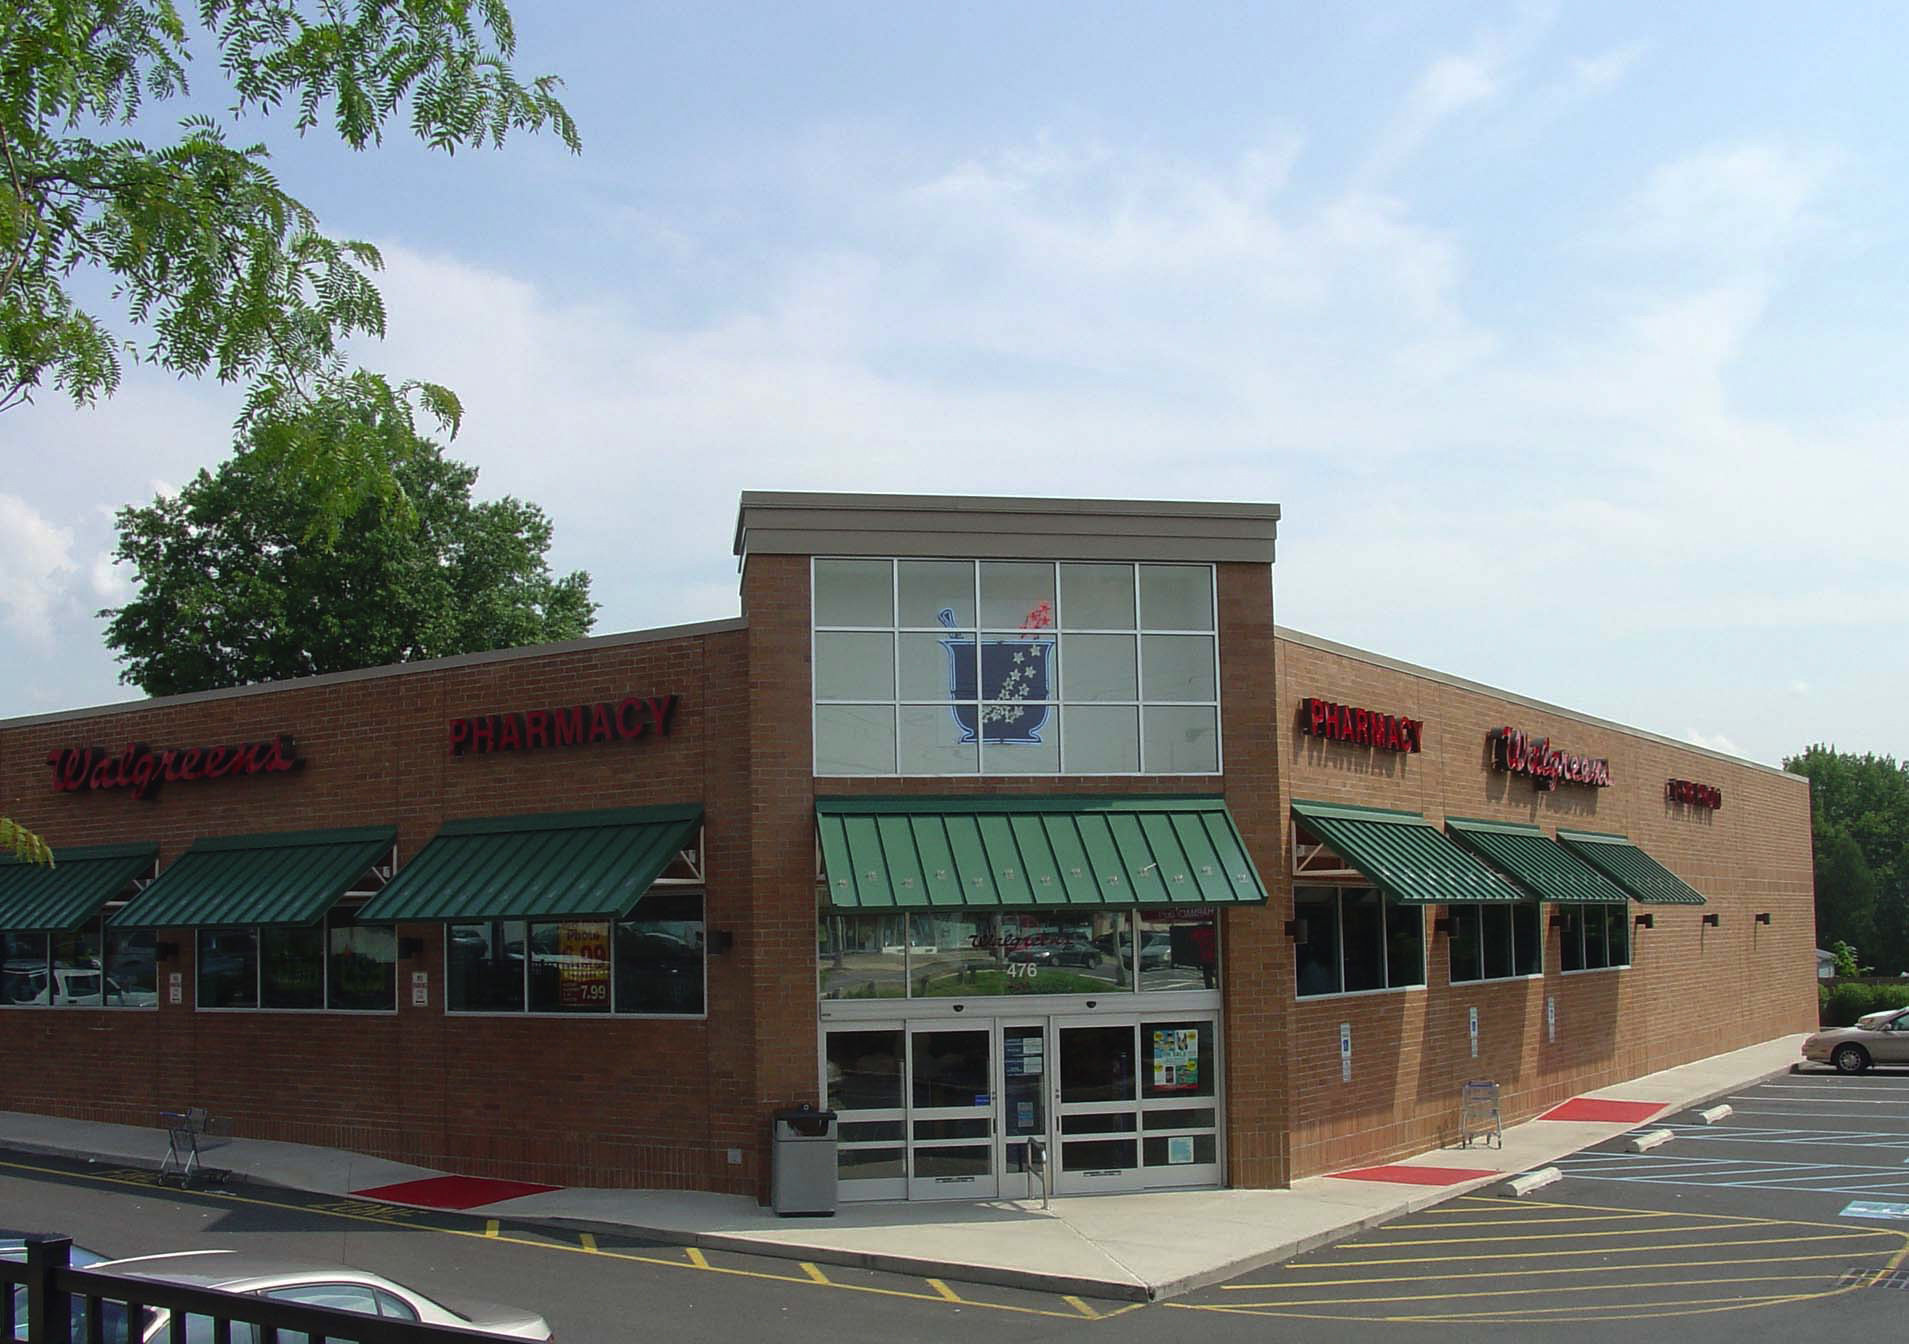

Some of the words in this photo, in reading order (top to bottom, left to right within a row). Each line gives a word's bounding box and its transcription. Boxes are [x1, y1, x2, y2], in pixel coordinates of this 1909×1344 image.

[448, 695, 677, 755] PHARMACY
[1304, 698, 1423, 752] PHARMACY
[48, 736, 297, 800] Walgreens
[580, 985, 606, 1000] 7.99
[1007, 962, 1038, 978] 476
